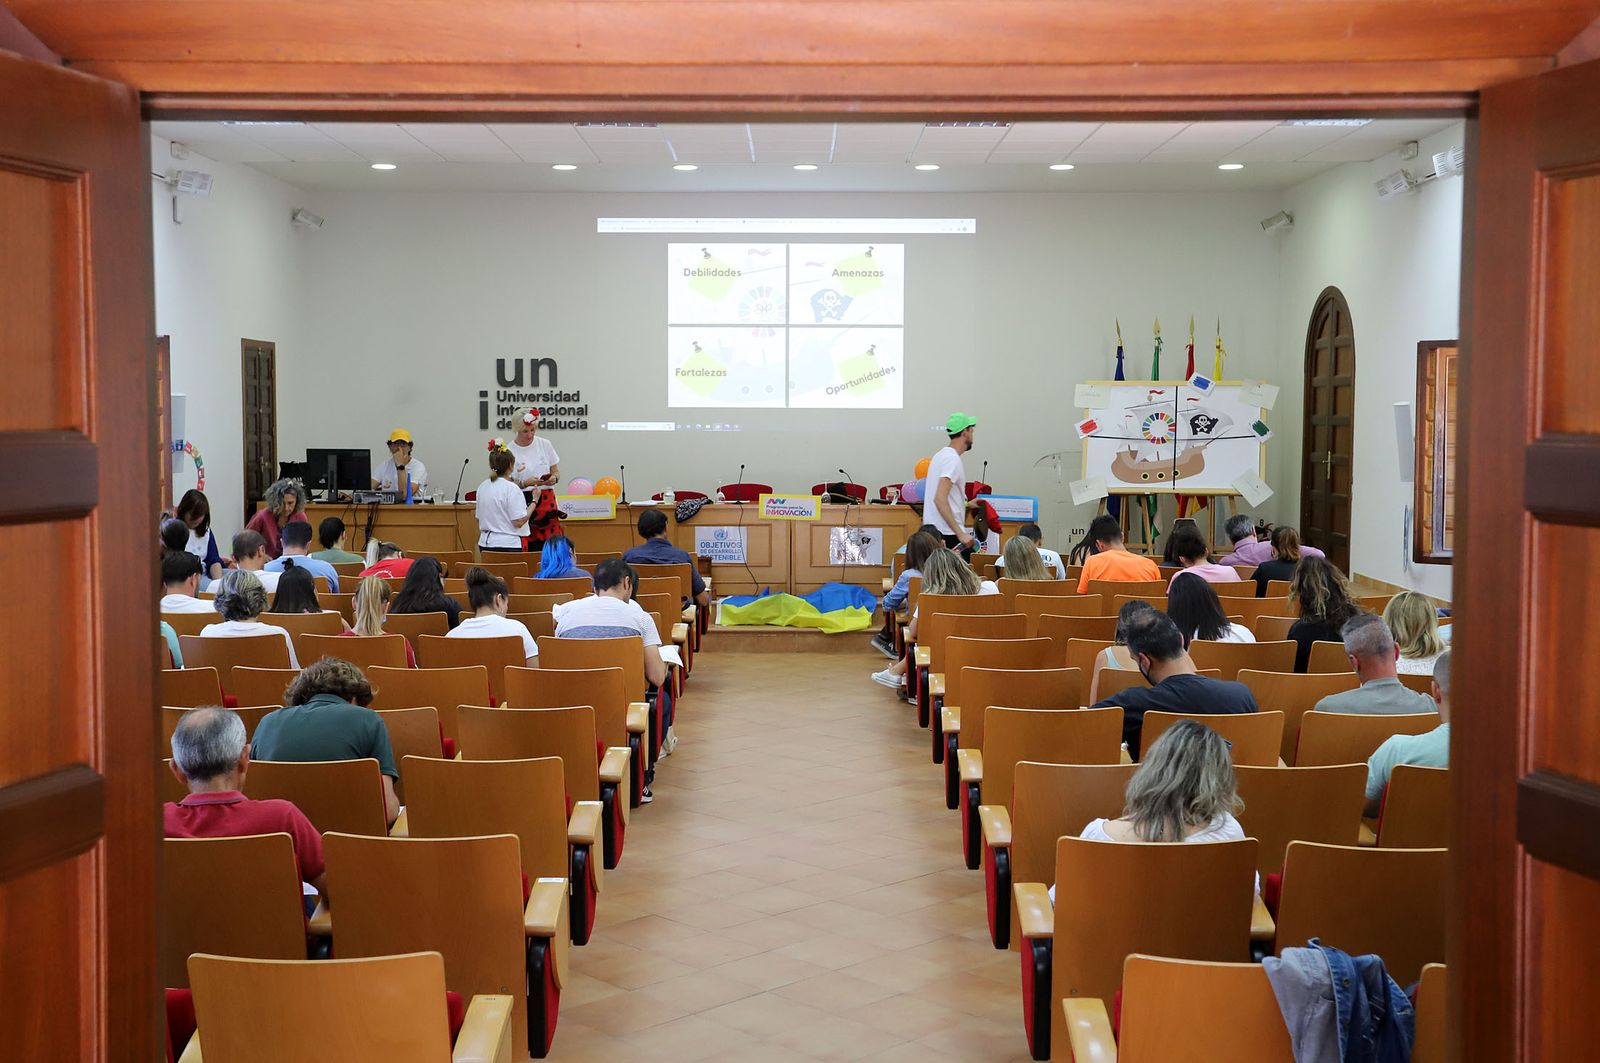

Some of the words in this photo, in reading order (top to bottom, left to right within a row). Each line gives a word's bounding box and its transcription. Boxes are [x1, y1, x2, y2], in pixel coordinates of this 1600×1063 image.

[683, 267, 742, 277] Debilidades
[831, 268, 885, 278] Amenazas
[496, 357, 558, 388] un
[675, 367, 728, 377] Fortalezas
[825, 365, 896, 395] Oportunidades
[496, 390, 580, 402] Universidad
[496, 404, 588, 416] Intacional
[537, 418, 588, 430] dalucía
[700, 541, 742, 549] OBJETIVOS
